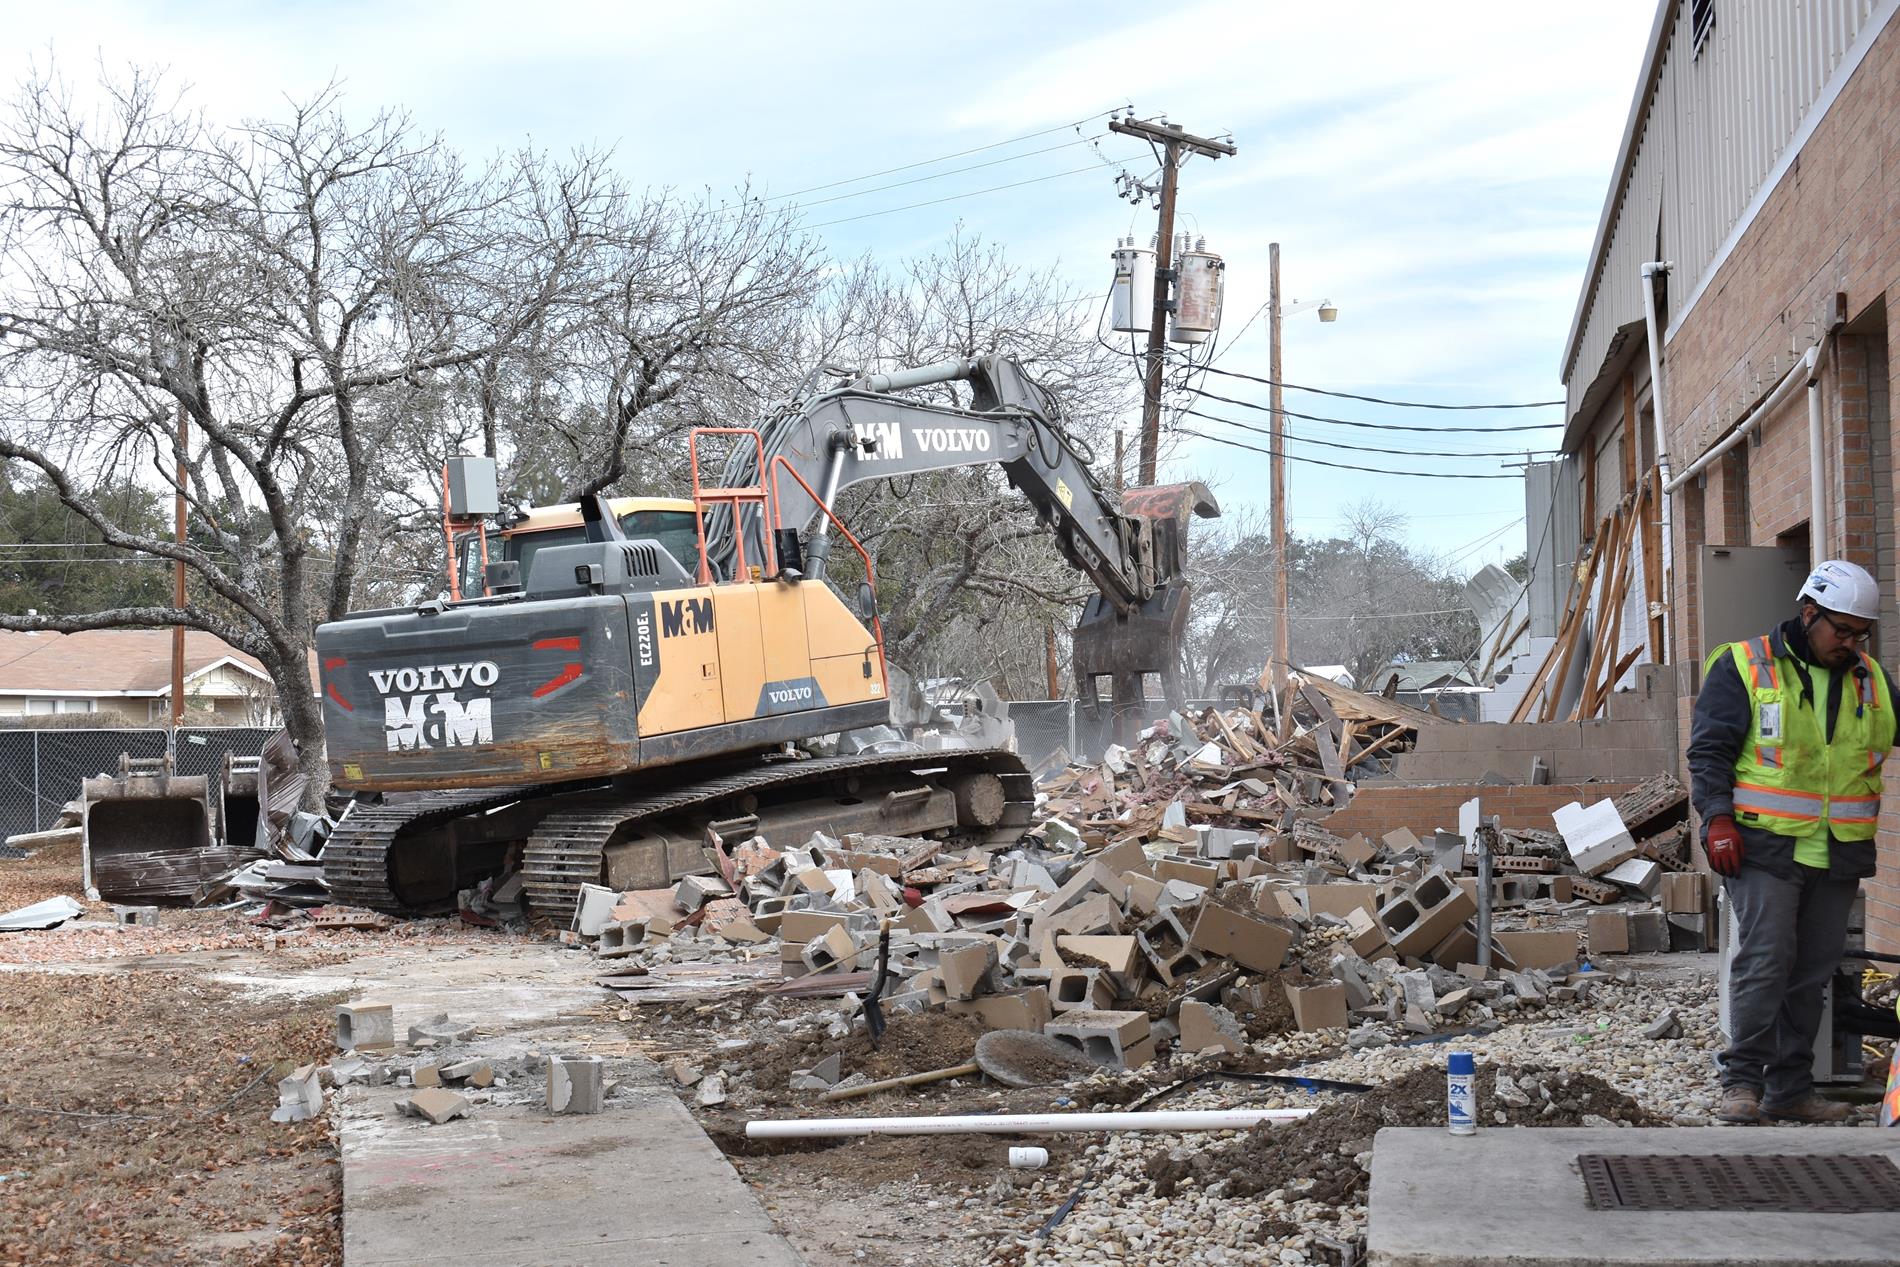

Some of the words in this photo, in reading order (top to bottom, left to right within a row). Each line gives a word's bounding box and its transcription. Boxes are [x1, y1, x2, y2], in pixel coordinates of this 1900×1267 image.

[854, 422, 904, 462] M&M
[912, 428, 991, 452] VOLVO
[660, 597, 715, 638] M&M
[368, 660, 500, 695] VOLVO
[768, 686, 812, 704] VOLVO
[382, 691, 494, 752] M&M
[1450, 1083, 1467, 1095] 2X
